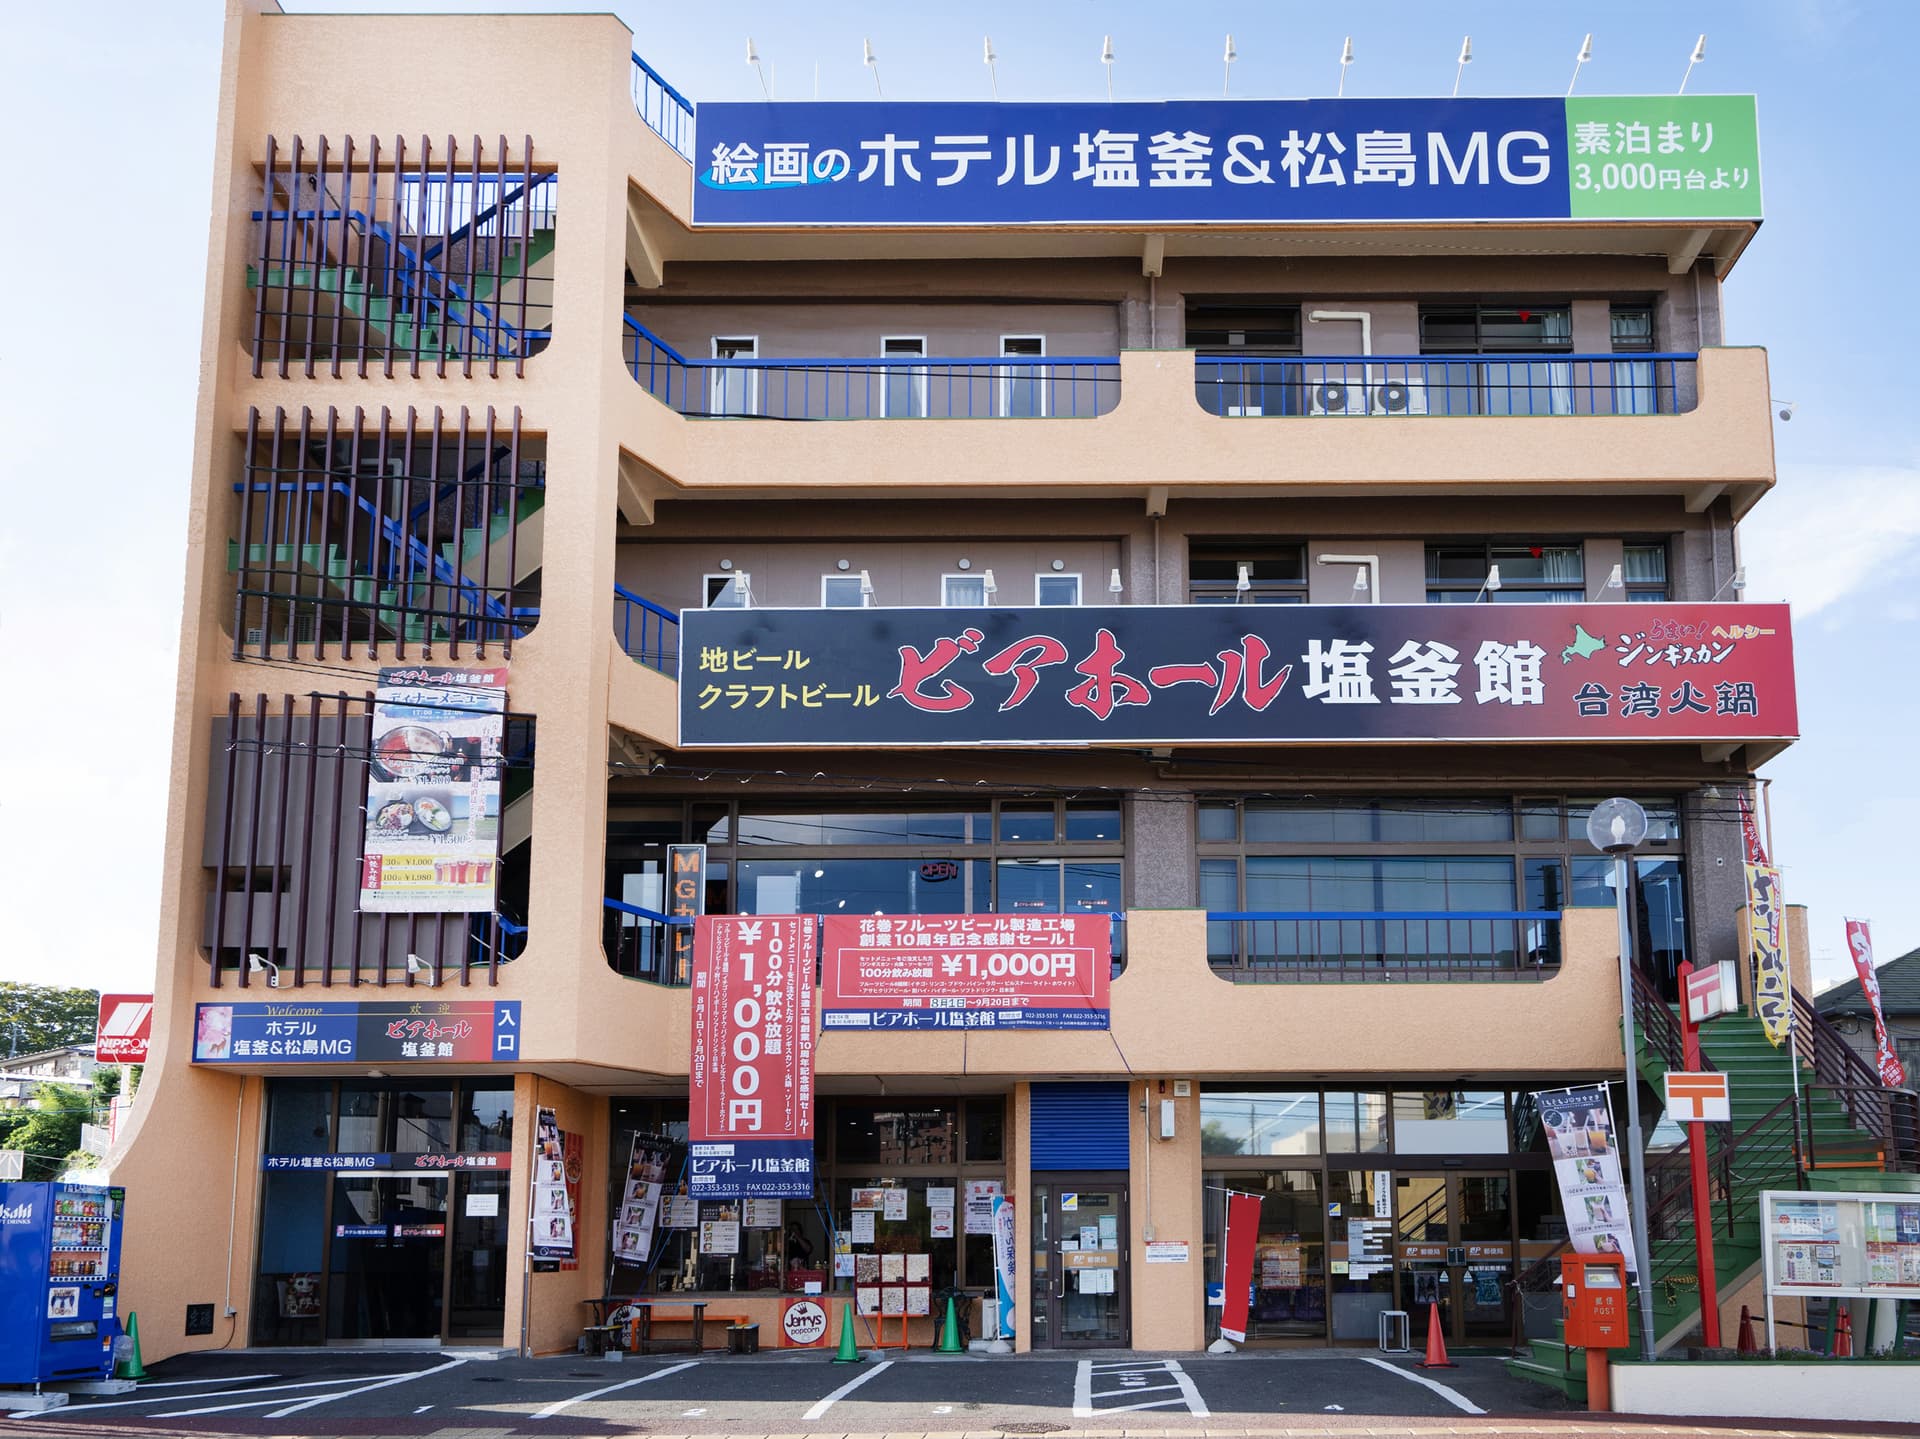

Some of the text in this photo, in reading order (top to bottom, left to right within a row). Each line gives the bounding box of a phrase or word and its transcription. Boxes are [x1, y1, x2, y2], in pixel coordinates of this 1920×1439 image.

[1574, 121, 1714, 154] 素泊まり
[1574, 161, 1750, 193] 3,000円台より
[1711, 624, 1776, 640] ヘルシー
[1613, 631, 1736, 667] ジンギスカン
[699, 646, 810, 674] 地ビール
[888, 627, 1548, 720] ビアホール塩釜館
[391, 692, 489, 703] ディナーメニュー
[699, 683, 880, 709] クラフトビール
[1572, 681, 1759, 719] 台湾火鍋
[920, 863, 957, 877] OPEN
[859, 918, 1076, 932] 花巻フルーツビール製造工場
[860, 967, 933, 978] 100分飲み放題
[941, 953, 1076, 980] ¥1,000円
[696, 972, 707, 988] 期間
[763, 921, 783, 1055] 100分飲み放題
[265, 1004, 323, 1016] Welcome
[903, 998, 922, 1007] 期間
[873, 1011, 995, 1026] ビアホール塩釜館
[266, 1021, 317, 1036] ホテル
[385, 1019, 473, 1040] ビアホール
[497, 1009, 515, 1051] 入口
[728, 921, 763, 1132] ¥1,000円
[99, 1039, 150, 1048] NIPPON
[233, 1039, 352, 1056] 塩釜&松島MG
[401, 1041, 455, 1057] 塩釜館
[268, 1155, 497, 1168] ホテル塩釜&松島MG ビアホール塩釜館
[692, 1158, 810, 1173] ビアホール塩釜館
[692, 1182, 810, 1191] 022-353-5315 FAX 022-353-5316
[0, 1203, 32, 1218] sahi
[1593, 1306, 1615, 1315] POST
[786, 1313, 822, 1328] Jerrys
[791, 1327, 820, 1336] popcorn
